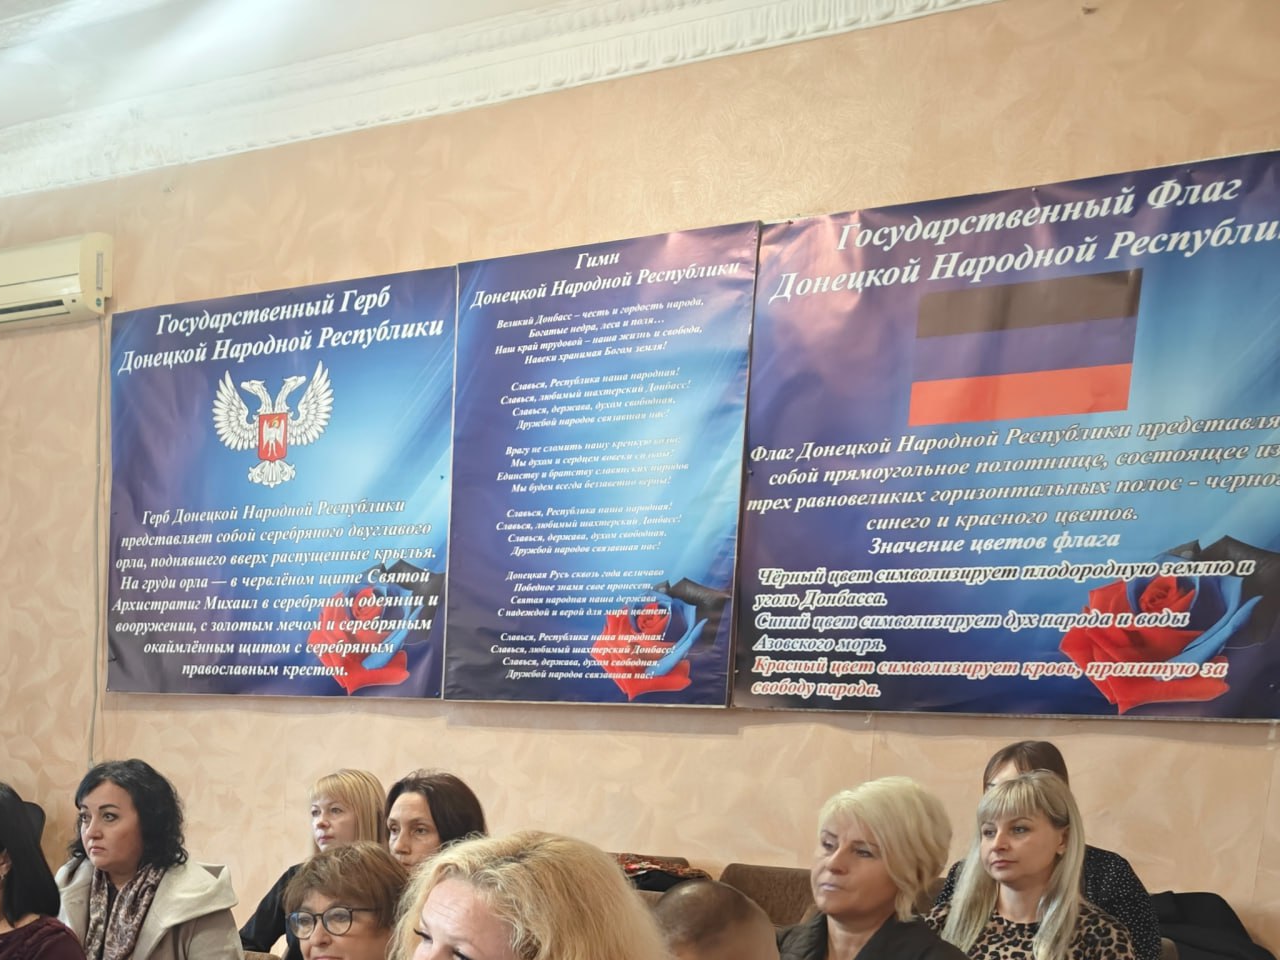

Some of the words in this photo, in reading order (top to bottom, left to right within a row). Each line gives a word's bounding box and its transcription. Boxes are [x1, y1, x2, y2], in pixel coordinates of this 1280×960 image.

[837, 185, 1135, 251] Государственный
[1147, 179, 1243, 209] Флаг
[575, 252, 620, 270] Гимн
[768, 258, 921, 305] Донецкой
[927, 235, 1098, 283] Народной
[1104, 217, 1280, 258] Республи
[469, 283, 547, 310] Донецкой
[551, 271, 632, 298] Народной
[637, 262, 740, 285] Республики
[156, 293, 335, 336] Государственный
[339, 285, 391, 315] Герб
[496, 317, 534, 329] Великий
[534, 313, 572, 325] Донбасс
[582, 309, 609, 318] честь
[620, 302, 664, 315] гордость
[528, 326, 568, 338] Богатые
[600, 320, 620, 330] леса
[117, 342, 207, 376] Донецкой
[211, 330, 312, 363] Народной
[317, 319, 444, 349] Республики
[495, 345, 515, 355] Наш
[517, 342, 538, 354] край
[540, 337, 583, 351] трудовой
[592, 333, 617, 344] наша
[618, 331, 651, 341] жизнь
[524, 354, 556, 364] Навеки
[557, 349, 602, 363] хранимая
[604, 347, 632, 356] Богом
[635, 341, 668, 353] земля!
[750, 446, 794, 461] Флаг
[795, 437, 892, 462] Донецкой
[896, 430, 999, 455] Народной
[1004, 424, 1132, 447] Республики
[769, 467, 819, 486] собой
[823, 461, 970, 486] прямоугольное
[975, 454, 1109, 474] полотнище,
[1115, 445, 1249, 465] состоящее
[746, 498, 792, 514] трех
[793, 491, 926, 513] равновеликих
[930, 481, 1110, 506] горизонтальных
[1115, 477, 1183, 494] полос
[142, 510, 170, 528] Герб
[172, 507, 238, 526] Донецкой
[243, 502, 313, 522] Народной
[317, 498, 405, 517] Республики
[866, 517, 931, 530] синего
[937, 514, 949, 527] и
[955, 510, 1048, 531] красного
[1054, 506, 1138, 525] цветов.
[121, 533, 213, 550] представляет
[216, 528, 256, 543] собой
[260, 526, 344, 545] серебряного
[348, 523, 432, 540] двуглавого
[868, 537, 965, 554] Значение
[970, 536, 1047, 554] цветов
[1053, 531, 1121, 554] флага
[116, 558, 147, 572] орла,
[151, 553, 227, 568] поднявшего
[230, 553, 269, 568] вверх
[271, 549, 370, 567] распущенные
[374, 547, 437, 563] крылья.
[120, 576, 139, 590] На
[142, 576, 176, 592] груди
[179, 577, 208, 592] орла
[230, 577, 237, 588] в
[242, 570, 314, 590] червлёном
[319, 573, 362, 586] щите
[367, 568, 431, 584] Святой
[504, 570, 547, 581] Донецкая
[549, 570, 569, 581] Русь
[571, 570, 600, 579] сквозь
[601, 569, 621, 578] года
[623, 569, 665, 577] величаво
[759, 567, 826, 588] Чёрный
[828, 569, 872, 587] цвет
[875, 565, 1020, 585] символизирует
[1021, 559, 1158, 583] плодородную
[1160, 561, 1234, 577] землю
[1236, 560, 1256, 576] и
[513, 583, 555, 592] Победное
[556, 583, 584, 591] знамя
[112, 598, 201, 614] Архистратиг
[203, 596, 258, 610] Михаил
[261, 599, 269, 609] в
[273, 594, 354, 612] серебряном
[358, 592, 424, 607] одеянии
[428, 595, 439, 606] и
[510, 595, 544, 605] Святая
[545, 595, 587, 605] народная
[588, 595, 614, 603] наша
[616, 594, 657, 605] держава
[752, 594, 800, 610] уголь
[799, 589, 887, 610] Донбасса.
[505, 607, 550, 617] надеждой
[559, 607, 584, 618] верой
[586, 607, 603, 616] для
[604, 608, 628, 617] мира
[755, 612, 811, 630] Синий
[812, 615, 858, 632] цвет
[859, 614, 1001, 633] символизирует
[1003, 609, 1039, 632] дух
[1040, 608, 1112, 632] народа
[1115, 612, 1134, 627] и
[1135, 608, 1191, 627] воды
[115, 621, 197, 635] вооружении,
[200, 622, 208, 632] с
[210, 620, 273, 632] золотым
[277, 620, 321, 631] мечом
[326, 620, 334, 631] и
[339, 616, 432, 634] серебряным
[143, 640, 234, 654] окаймлённым
[238, 643, 290, 656] щитом
[294, 644, 302, 654] с
[306, 640, 394, 657] серебряным
[500, 632, 536, 642] Славься,
[538, 632, 588, 643] Республика
[617, 632, 665, 643] народная!
[752, 634, 835, 651] Азовского
[835, 637, 887, 655] моря.
[490, 645, 527, 654] Славься,
[528, 645, 570, 654] любимый
[631, 644, 676, 655] Донбасс!
[181, 664, 278, 678] православным
[282, 665, 348, 679] крестом.
[505, 669, 547, 680] Дружбой
[548, 670, 583, 680] народов
[585, 671, 632, 679] связавшая
[634, 670, 655, 679] нас!
[752, 656, 828, 676] Красный
[829, 660, 875, 677] цвет
[877, 661, 1020, 680] символизирует
[1021, 661, 1085, 680] кровь,
[1086, 661, 1199, 681] пролитую
[1200, 662, 1229, 677] за
[751, 678, 814, 699] свободу
[816, 679, 881, 700] народа.
